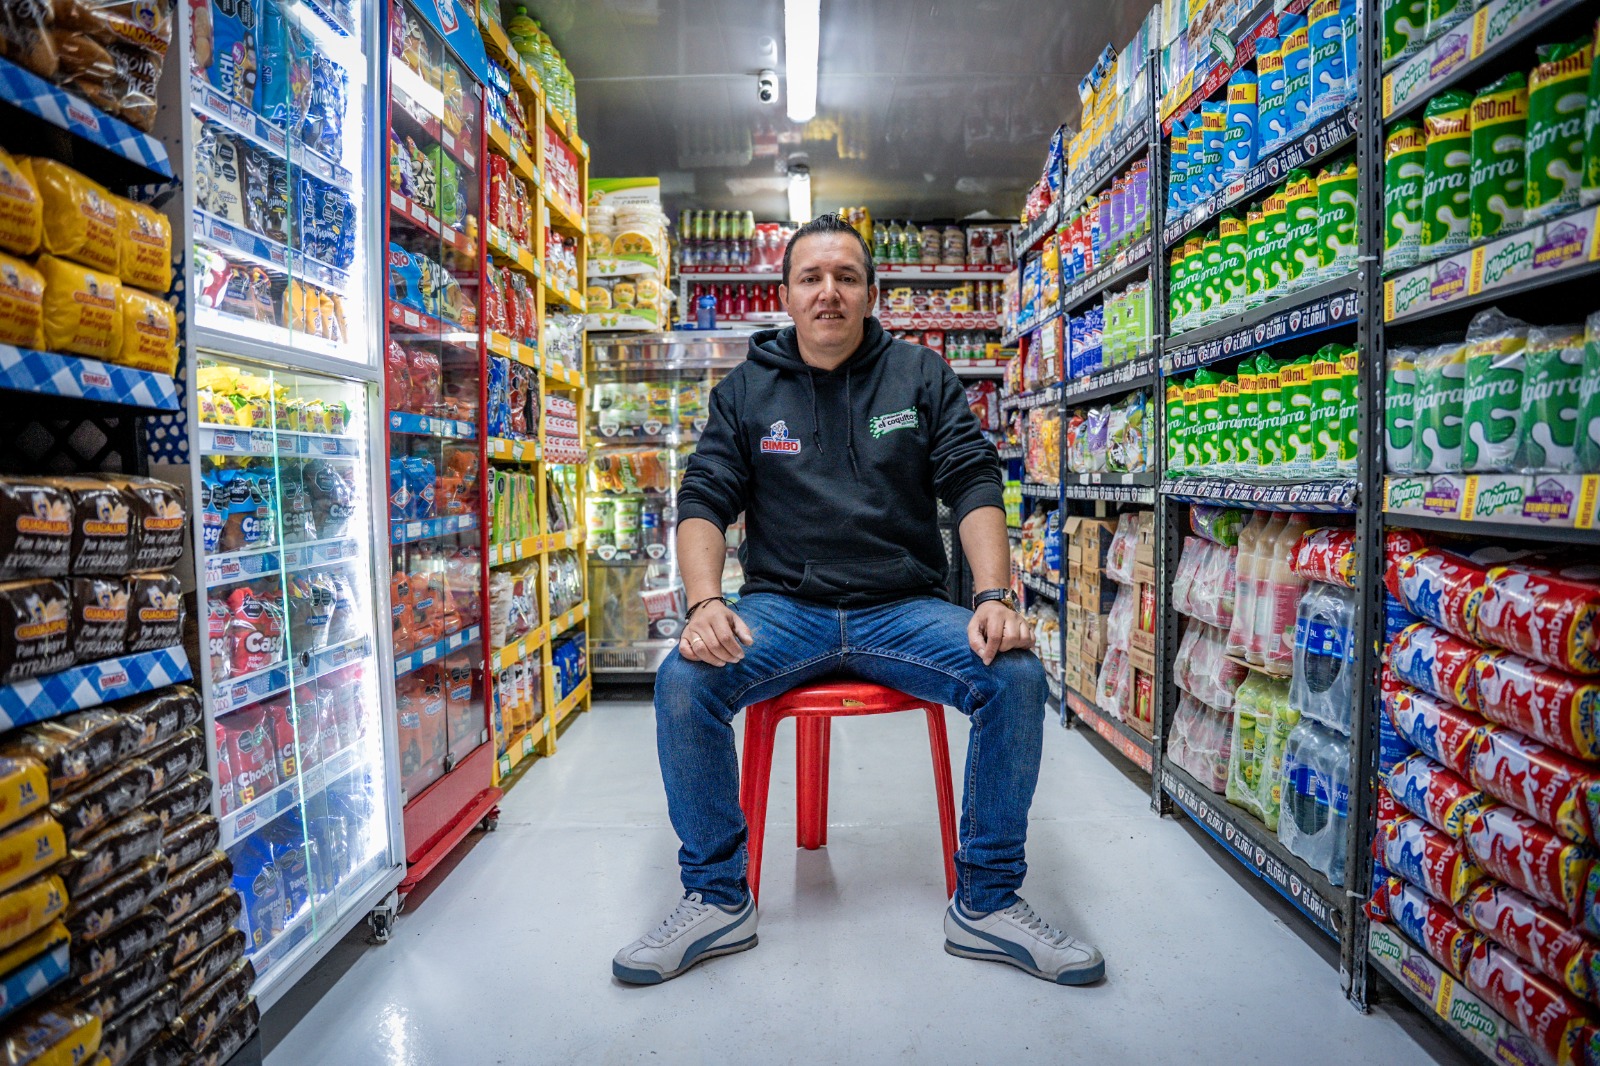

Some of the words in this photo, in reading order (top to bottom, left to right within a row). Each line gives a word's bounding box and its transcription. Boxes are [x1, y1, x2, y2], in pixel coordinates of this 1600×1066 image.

[1320, 128, 1348, 151] GLORIA
[1281, 153, 1304, 173] GLORIA
[1485, 242, 1533, 283] Algarra
[1396, 278, 1429, 312] Algarra
[1303, 310, 1326, 328] GLORIA
[1266, 322, 1286, 339] GLORIA
[1233, 336, 1252, 351] GLORIA
[1182, 353, 1196, 366] GLORIA
[83, 373, 110, 386] BIMBO
[879, 420, 886, 429] el
[887, 414, 914, 425] coquito
[217, 436, 234, 446] BIMBO
[762, 441, 798, 451] BIMBO
[1389, 479, 1424, 508] Algarra
[1476, 482, 1523, 516] Algarra
[222, 563, 240, 575] BIMBO
[101, 674, 127, 688] BIMBO
[286, 759, 294, 775] 5
[238, 812, 256, 829] BIMBO
[1207, 812, 1223, 833] GLORIA
[1234, 834, 1253, 858] GLORIA
[1266, 860, 1287, 887] GLORIA
[1302, 891, 1325, 920] GLORIA
[1371, 931, 1401, 959] Algarra
[1452, 1000, 1496, 1037] Algarra
